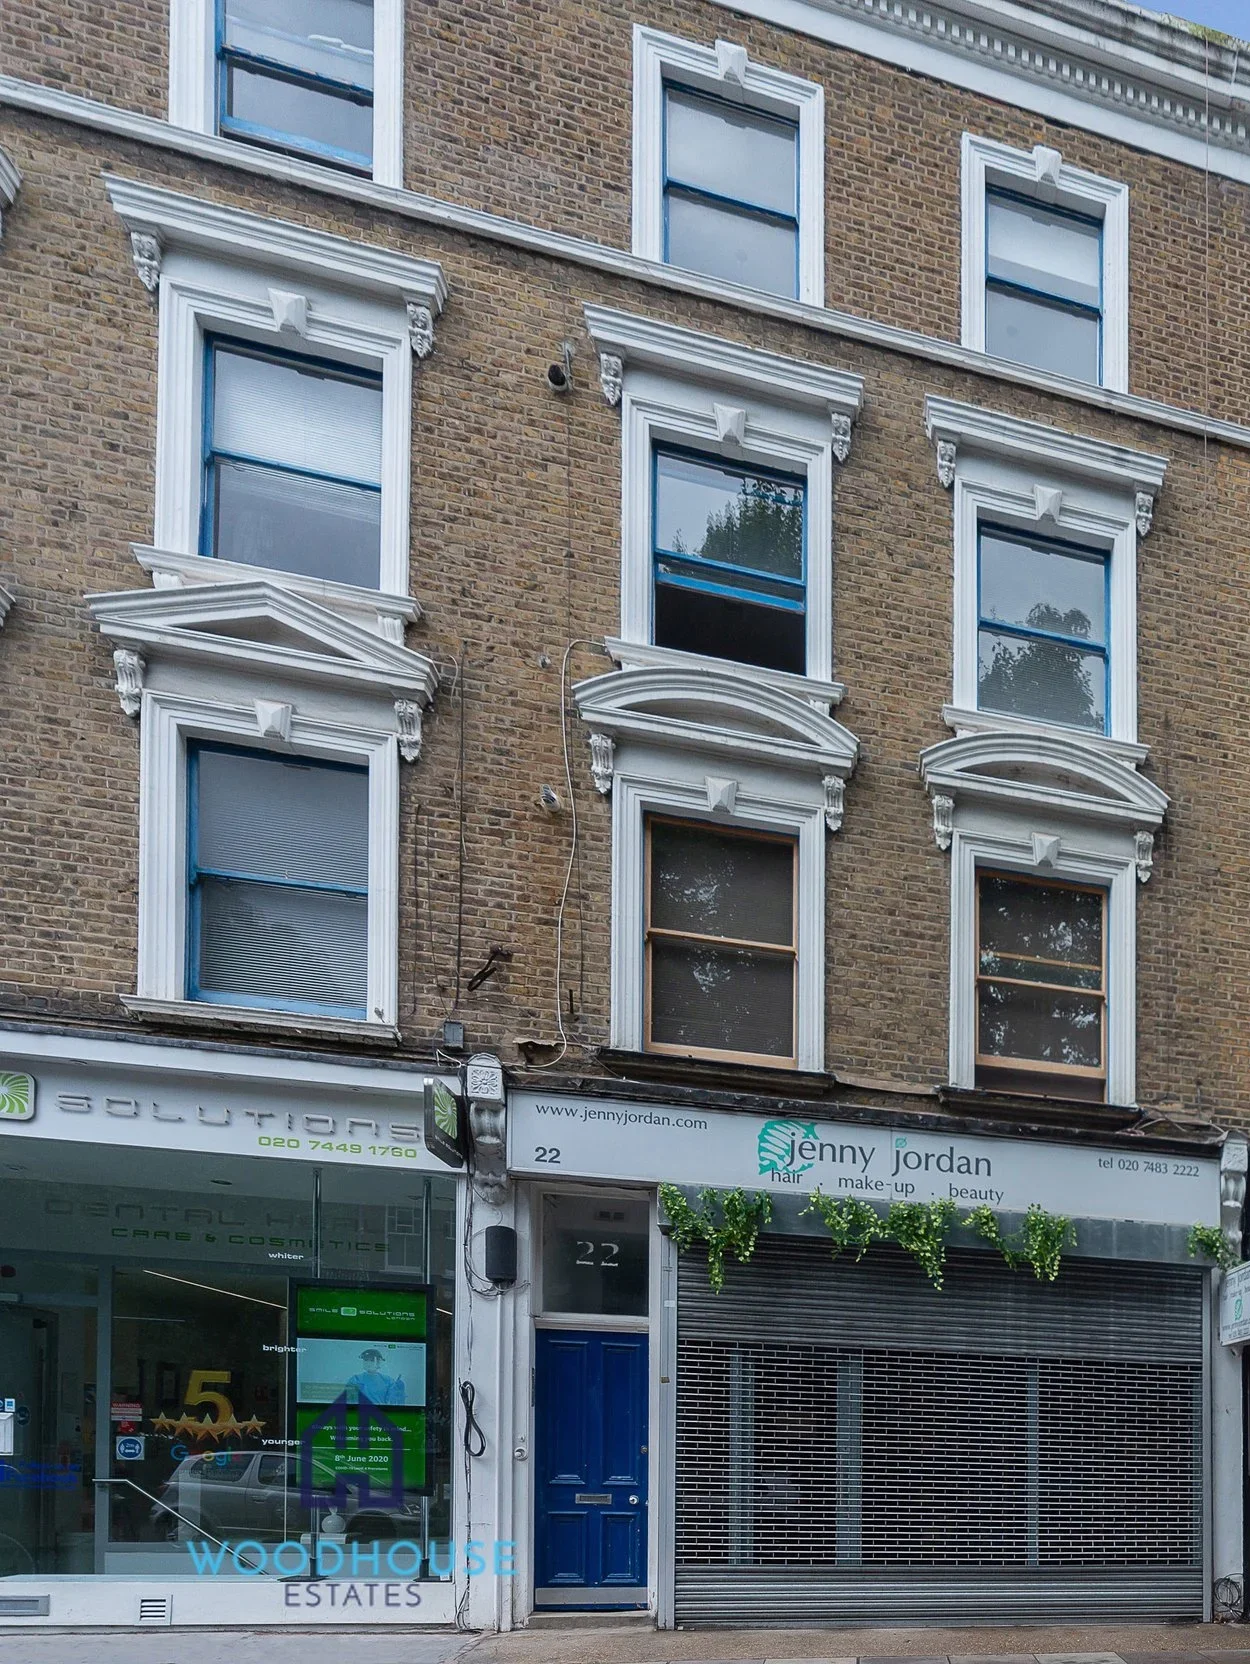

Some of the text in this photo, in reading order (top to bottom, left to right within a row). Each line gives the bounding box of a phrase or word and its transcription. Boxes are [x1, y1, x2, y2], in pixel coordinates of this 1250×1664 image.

[55, 1091, 421, 1142] SOLUTIONS
[535, 1104, 708, 1130] www.jennyjordan.com
[258, 1136, 417, 1159] 020 7449 1760
[534, 1146, 561, 1164] 22
[786, 1131, 992, 1178] jenny jordan
[1098, 1157, 1200, 1177] tel 020 7483 2222
[771, 1167, 1004, 1205] hair make-up beauty
[112, 1228, 191, 1242] CARE
[205, 1233, 216, 1243] &
[268, 1252, 304, 1260] whiter
[576, 1240, 620, 1267] 22
[262, 1344, 307, 1354] brighter
[184, 1369, 234, 1434] 5
[261, 1438, 306, 1447] younger
[171, 1444, 243, 1466] Gogl
[368, 1455, 389, 1463] 2020
